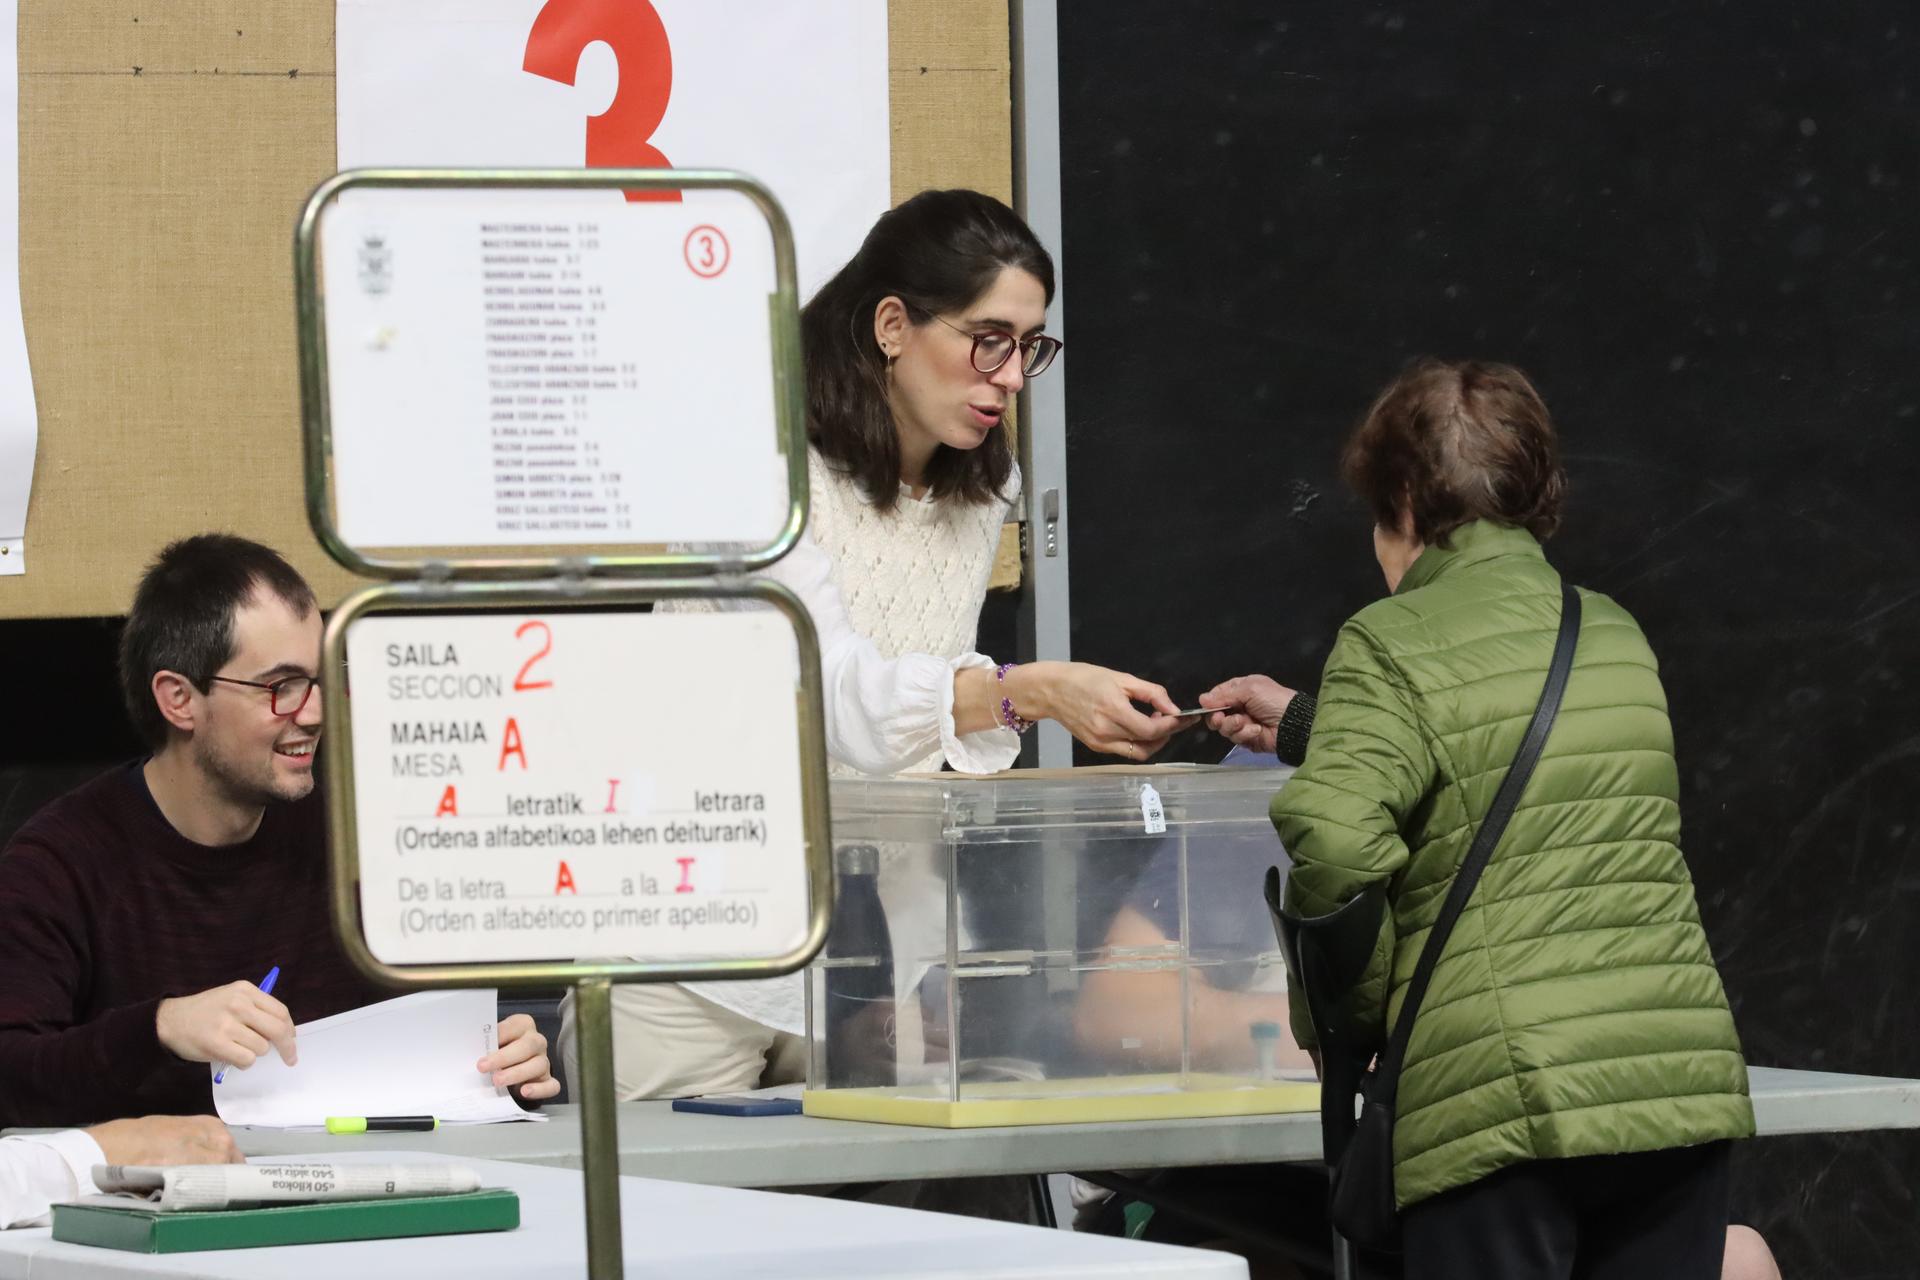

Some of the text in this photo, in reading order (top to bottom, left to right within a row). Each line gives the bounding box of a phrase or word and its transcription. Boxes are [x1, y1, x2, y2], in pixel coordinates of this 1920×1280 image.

[698, 236, 715, 268] 3
[387, 644, 459, 667] SAILA
[511, 621, 554, 692] 2
[388, 675, 502, 700] SECCION
[391, 721, 488, 744] MAHAIA
[498, 717, 528, 771] A
[392, 754, 463, 777] MESA
[435, 785, 458, 817] A
[506, 794, 583, 817] letratik
[694, 791, 766, 813] letrara
[395, 821, 768, 855] (Ordena alfabetikoa lehen deiturarik)
[398, 877, 428, 902] De
[434, 876, 454, 900] la
[460, 876, 506, 899] letra
[555, 861, 577, 895] A
[621, 878, 635, 896] a
[640, 873, 658, 896] la
[399, 900, 758, 934] (Orden alfabético primer apellido)
[272, 1180, 313, 1193] kilokoa
